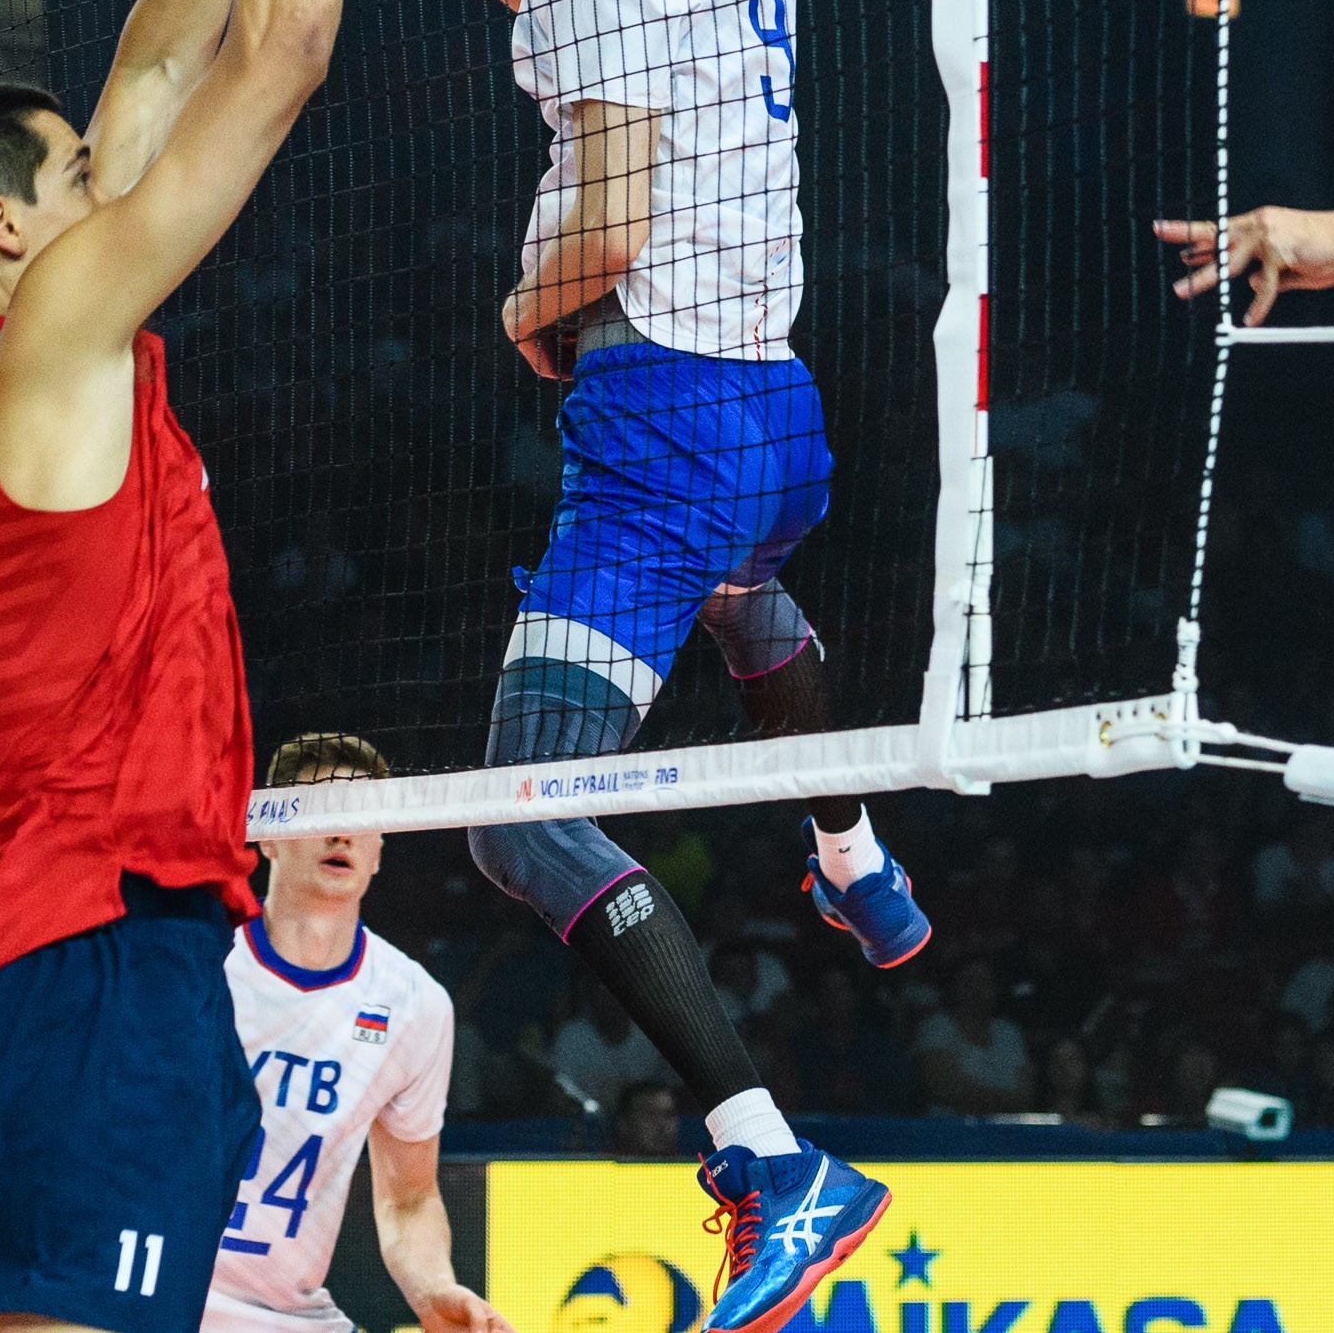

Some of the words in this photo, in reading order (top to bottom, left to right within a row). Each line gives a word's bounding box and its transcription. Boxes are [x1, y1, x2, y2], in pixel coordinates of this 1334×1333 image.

[541, 772, 619, 798] VOLLEYBALL
[613, 903, 655, 937] CEP
[114, 1229, 164, 1297] 11
